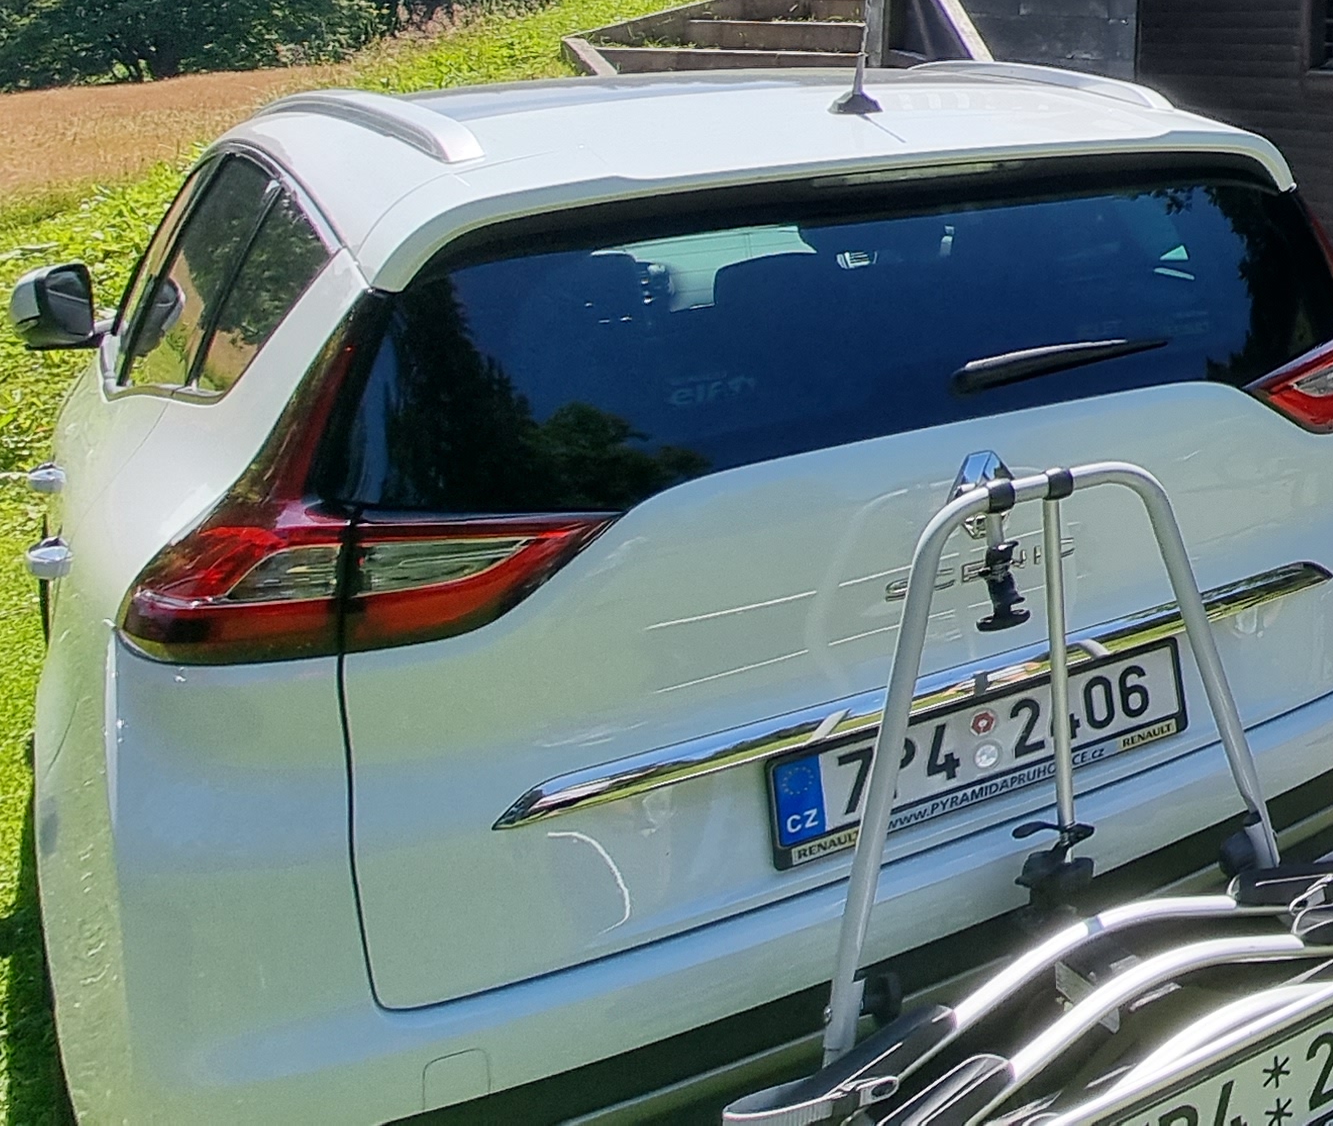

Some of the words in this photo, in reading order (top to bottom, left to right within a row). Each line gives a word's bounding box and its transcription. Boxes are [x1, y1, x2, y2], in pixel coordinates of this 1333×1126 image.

[1122, 723, 1172, 747] RENAULT
[888, 748, 1104, 830] www.PYRAMIDAPRUHOCE.cz
[786, 808, 819, 834] CZ
